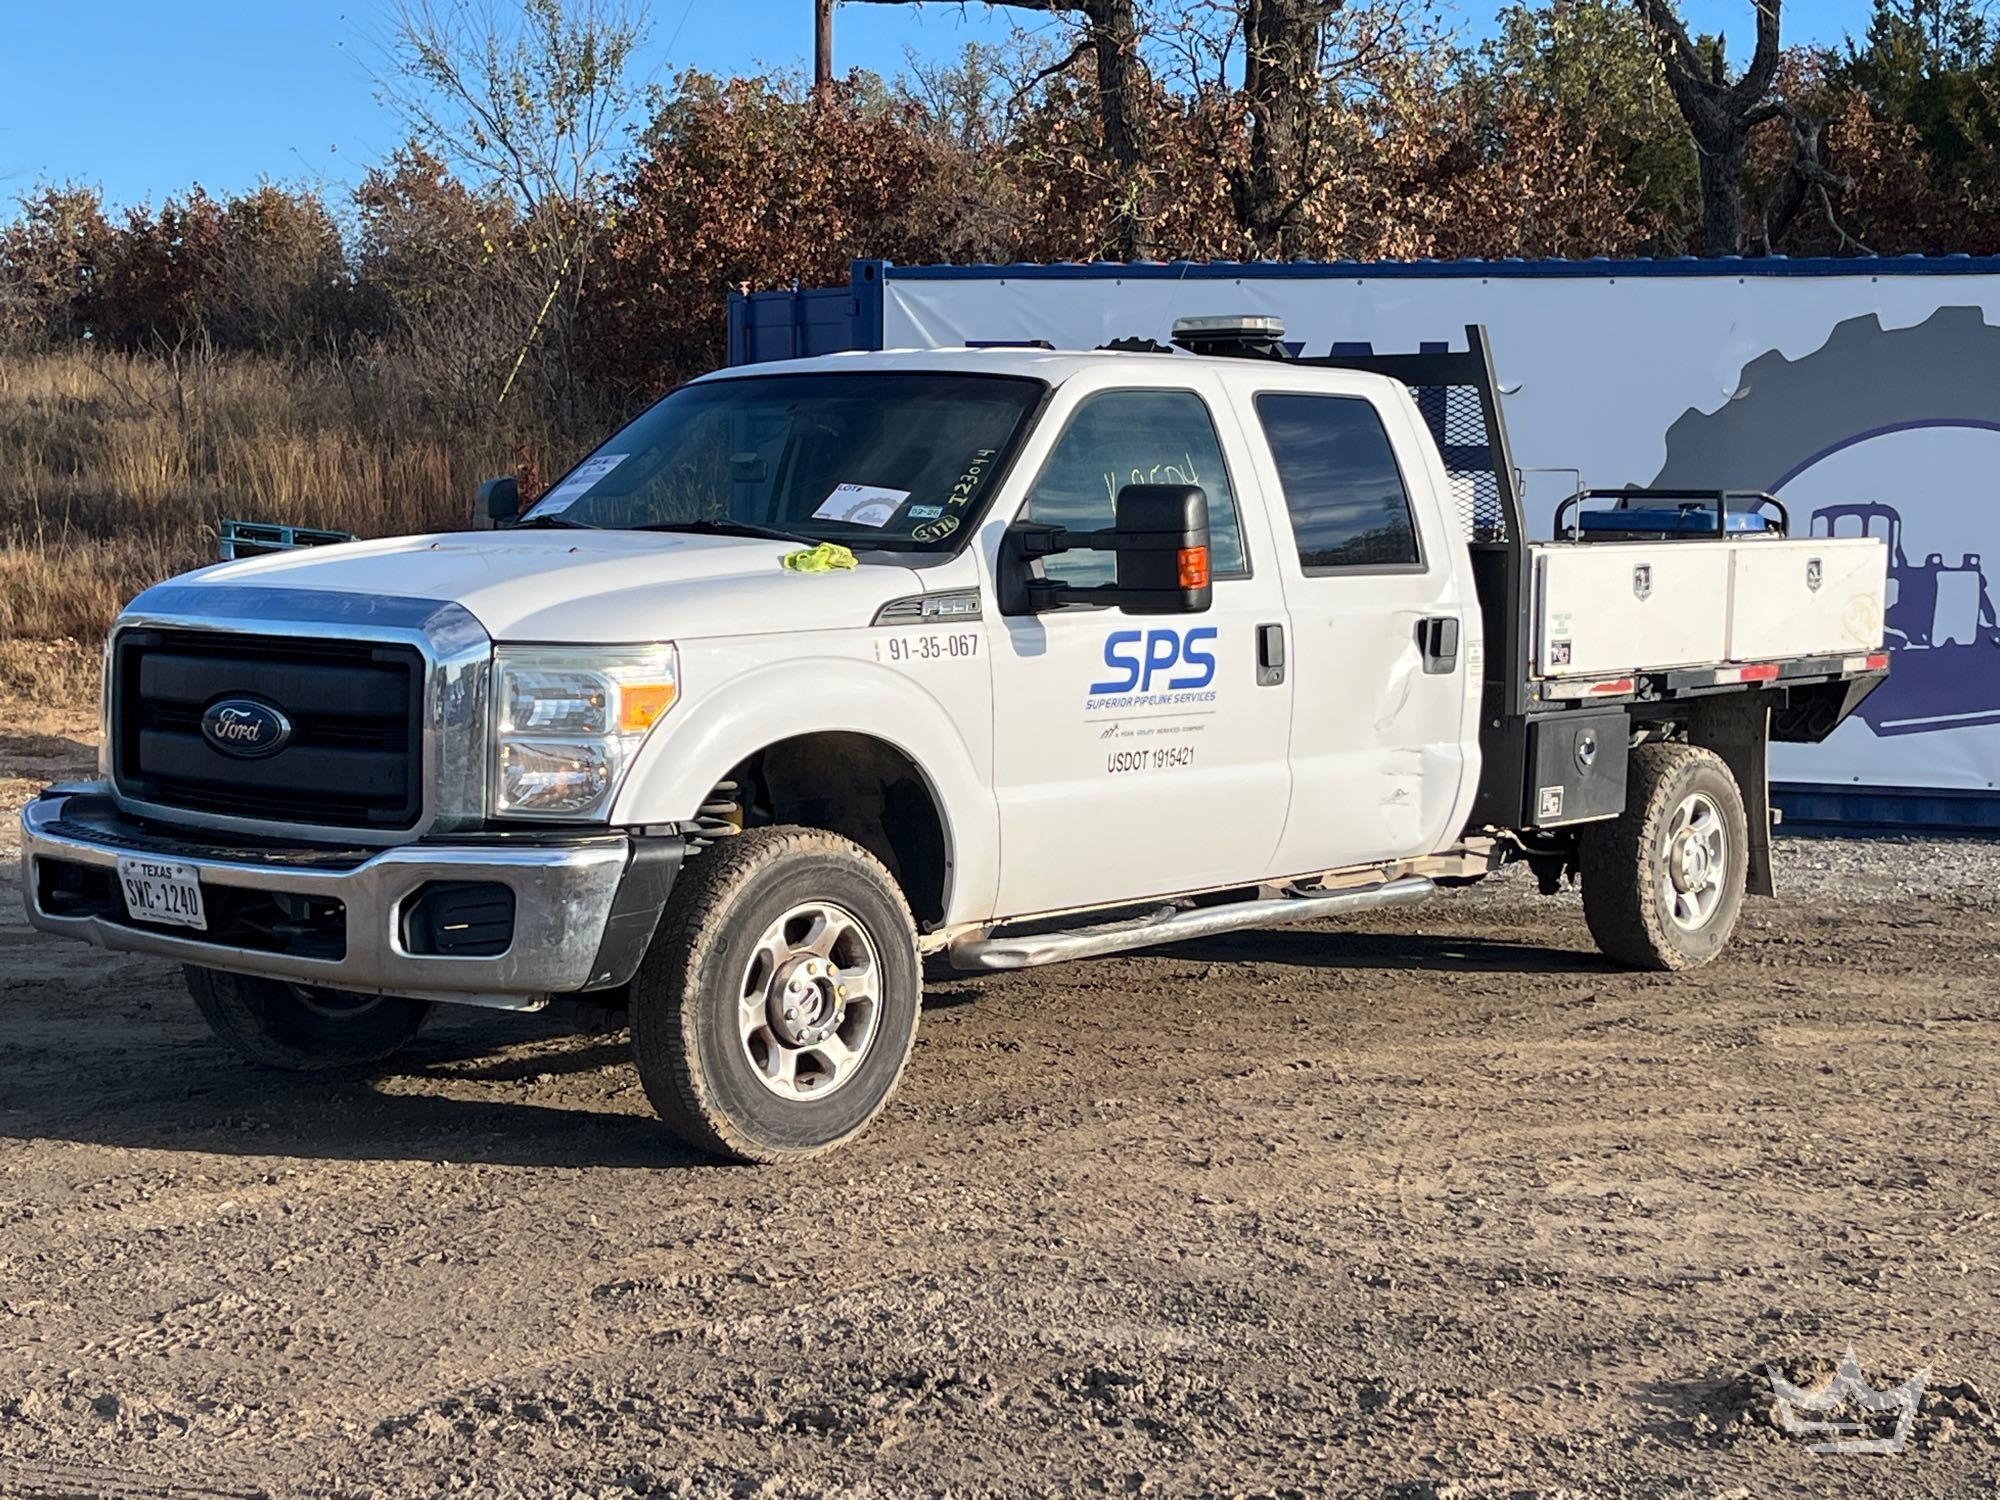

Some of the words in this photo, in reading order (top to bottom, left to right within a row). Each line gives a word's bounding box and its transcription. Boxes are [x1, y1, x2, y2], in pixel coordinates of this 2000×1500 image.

[888, 634, 979, 661] 91-35-067
[1089, 627, 1218, 695] SPS
[1085, 696, 1133, 710] SUPERIOR
[1134, 694, 1173, 708] PIPELINE
[1174, 691, 1217, 704] SERVICES
[214, 707, 263, 742] Ford
[1107, 750, 1149, 774] USDOT
[1152, 745, 1195, 769] 1915421
[141, 863, 173, 880] TEXAS
